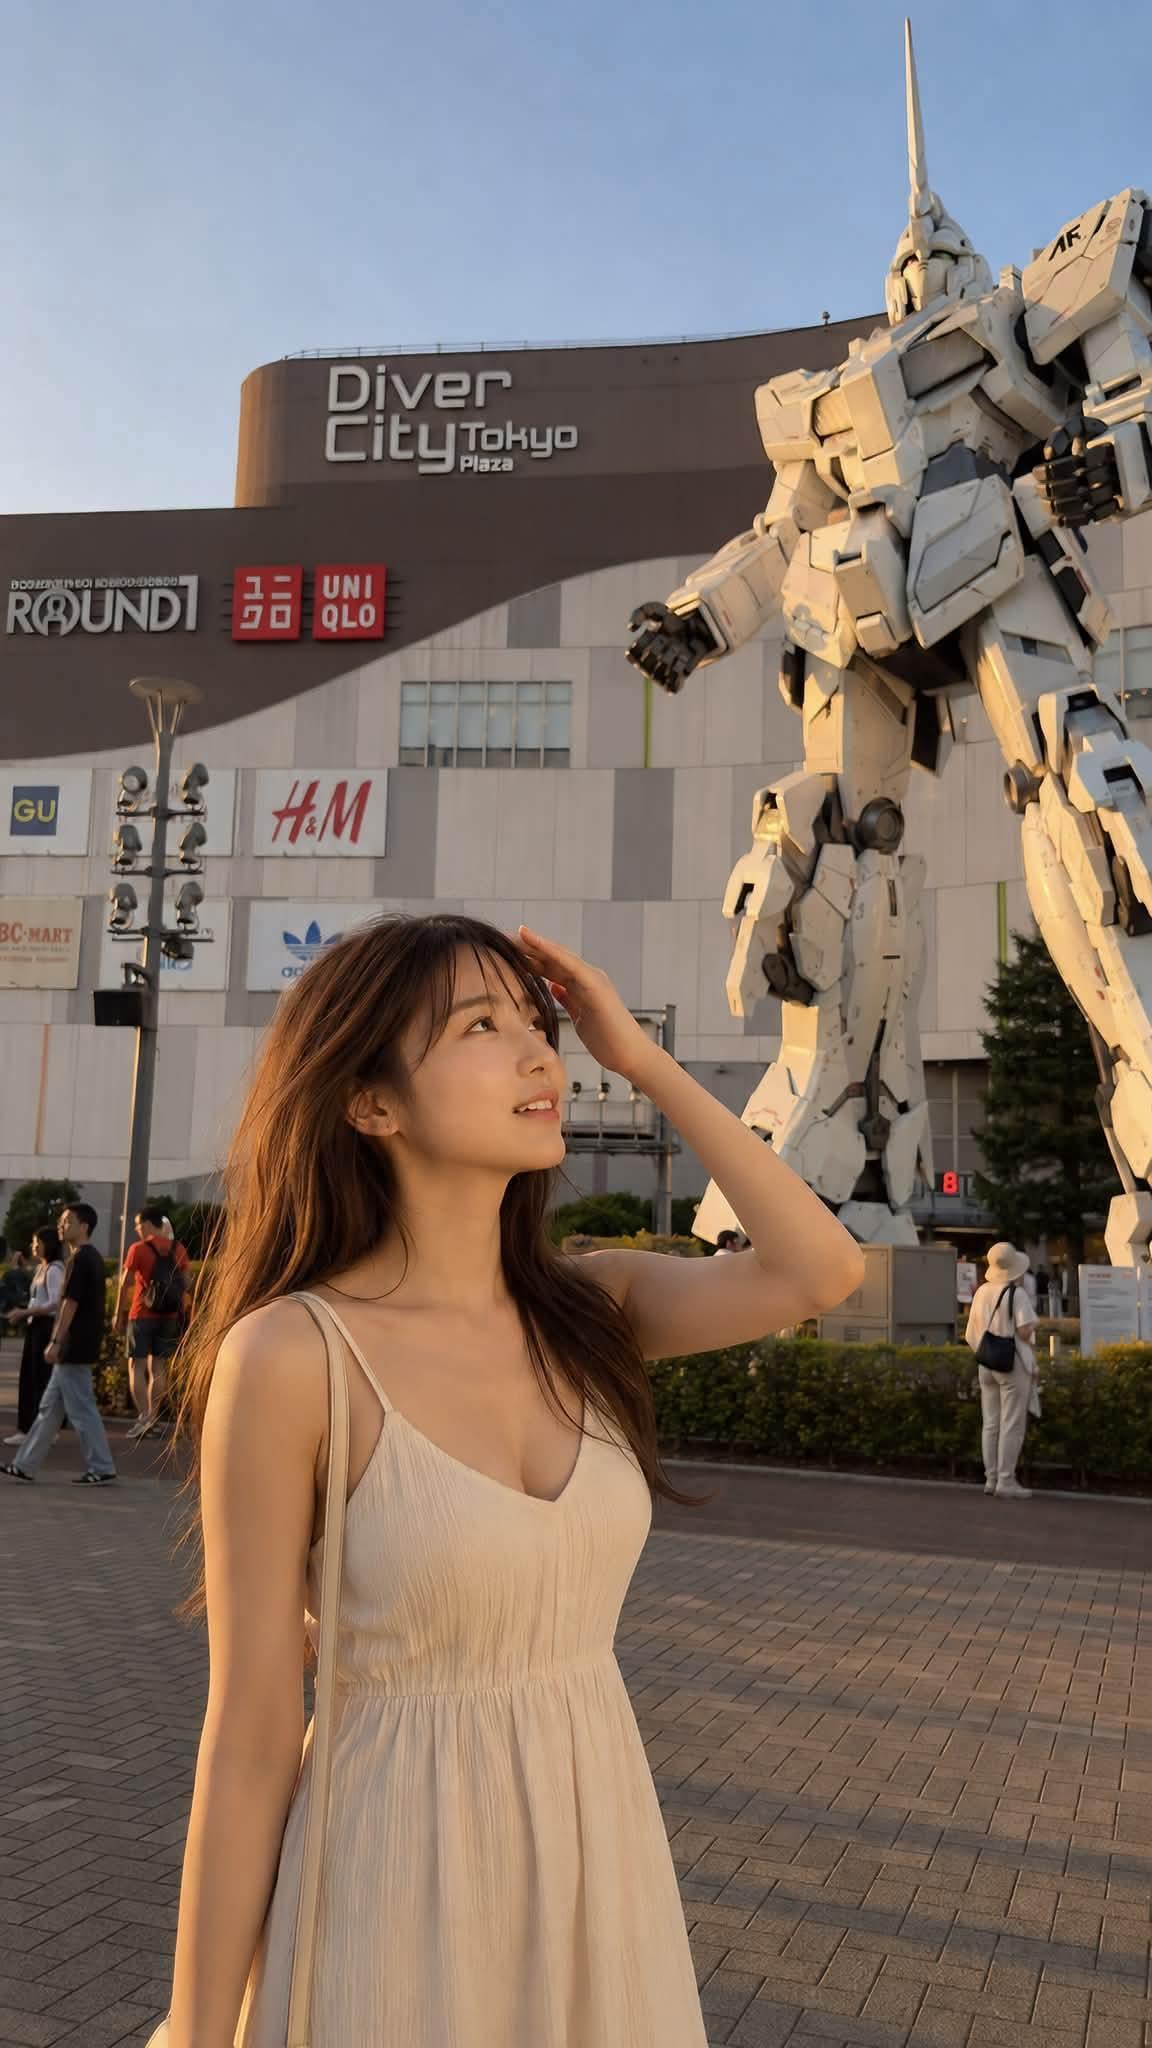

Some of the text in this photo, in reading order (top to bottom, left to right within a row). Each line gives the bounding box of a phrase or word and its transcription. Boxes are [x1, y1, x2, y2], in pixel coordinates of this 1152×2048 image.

[328, 364, 512, 412] Diver
[325, 414, 578, 474] City Tokyo
[459, 455, 514, 473] Plaza
[243, 575, 293, 600] ユニ
[322, 574, 373, 599] UNI
[239, 604, 292, 629] クロ
[321, 603, 376, 632] QLO
[14, 799, 56, 823] GU
[271, 779, 373, 844] H&M
